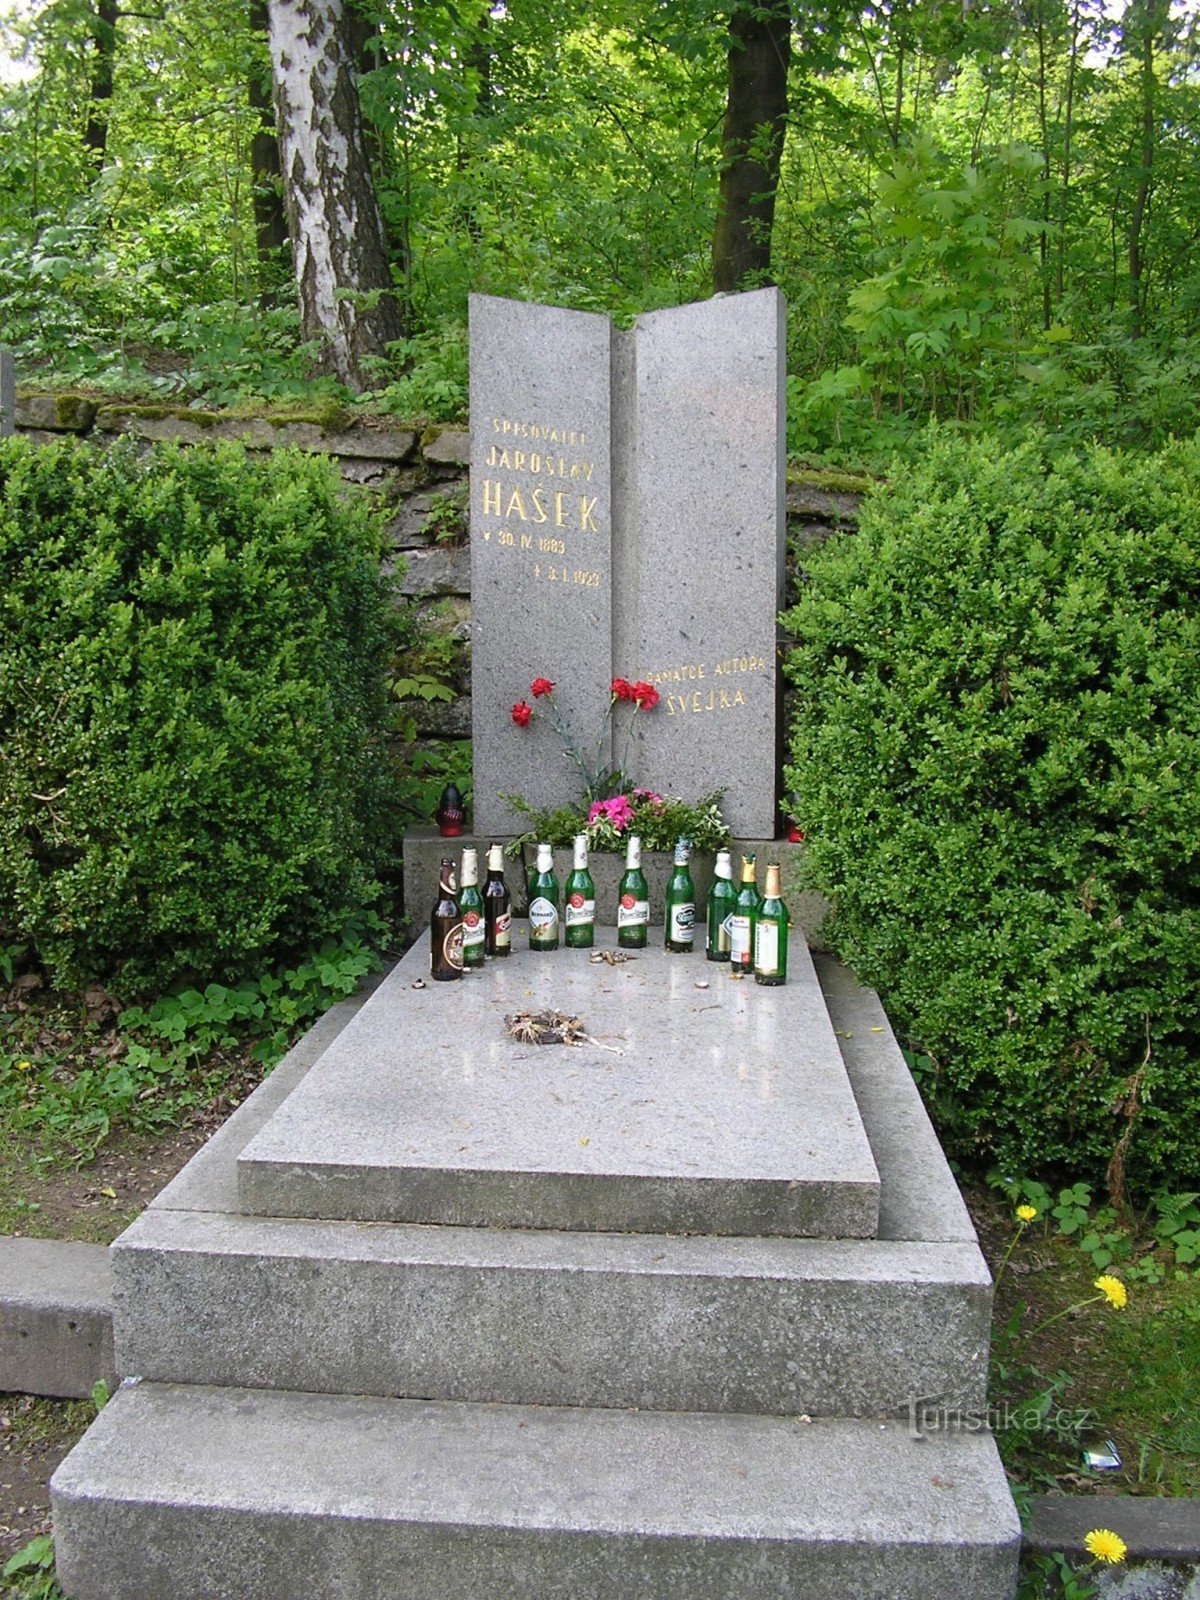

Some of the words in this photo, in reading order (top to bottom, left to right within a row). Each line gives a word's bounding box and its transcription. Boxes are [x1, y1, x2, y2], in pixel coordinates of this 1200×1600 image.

[486, 445, 594, 482] JAROSLAV
[482, 479, 599, 533] HAŠEK
[715, 655, 766, 675] AUTORA
